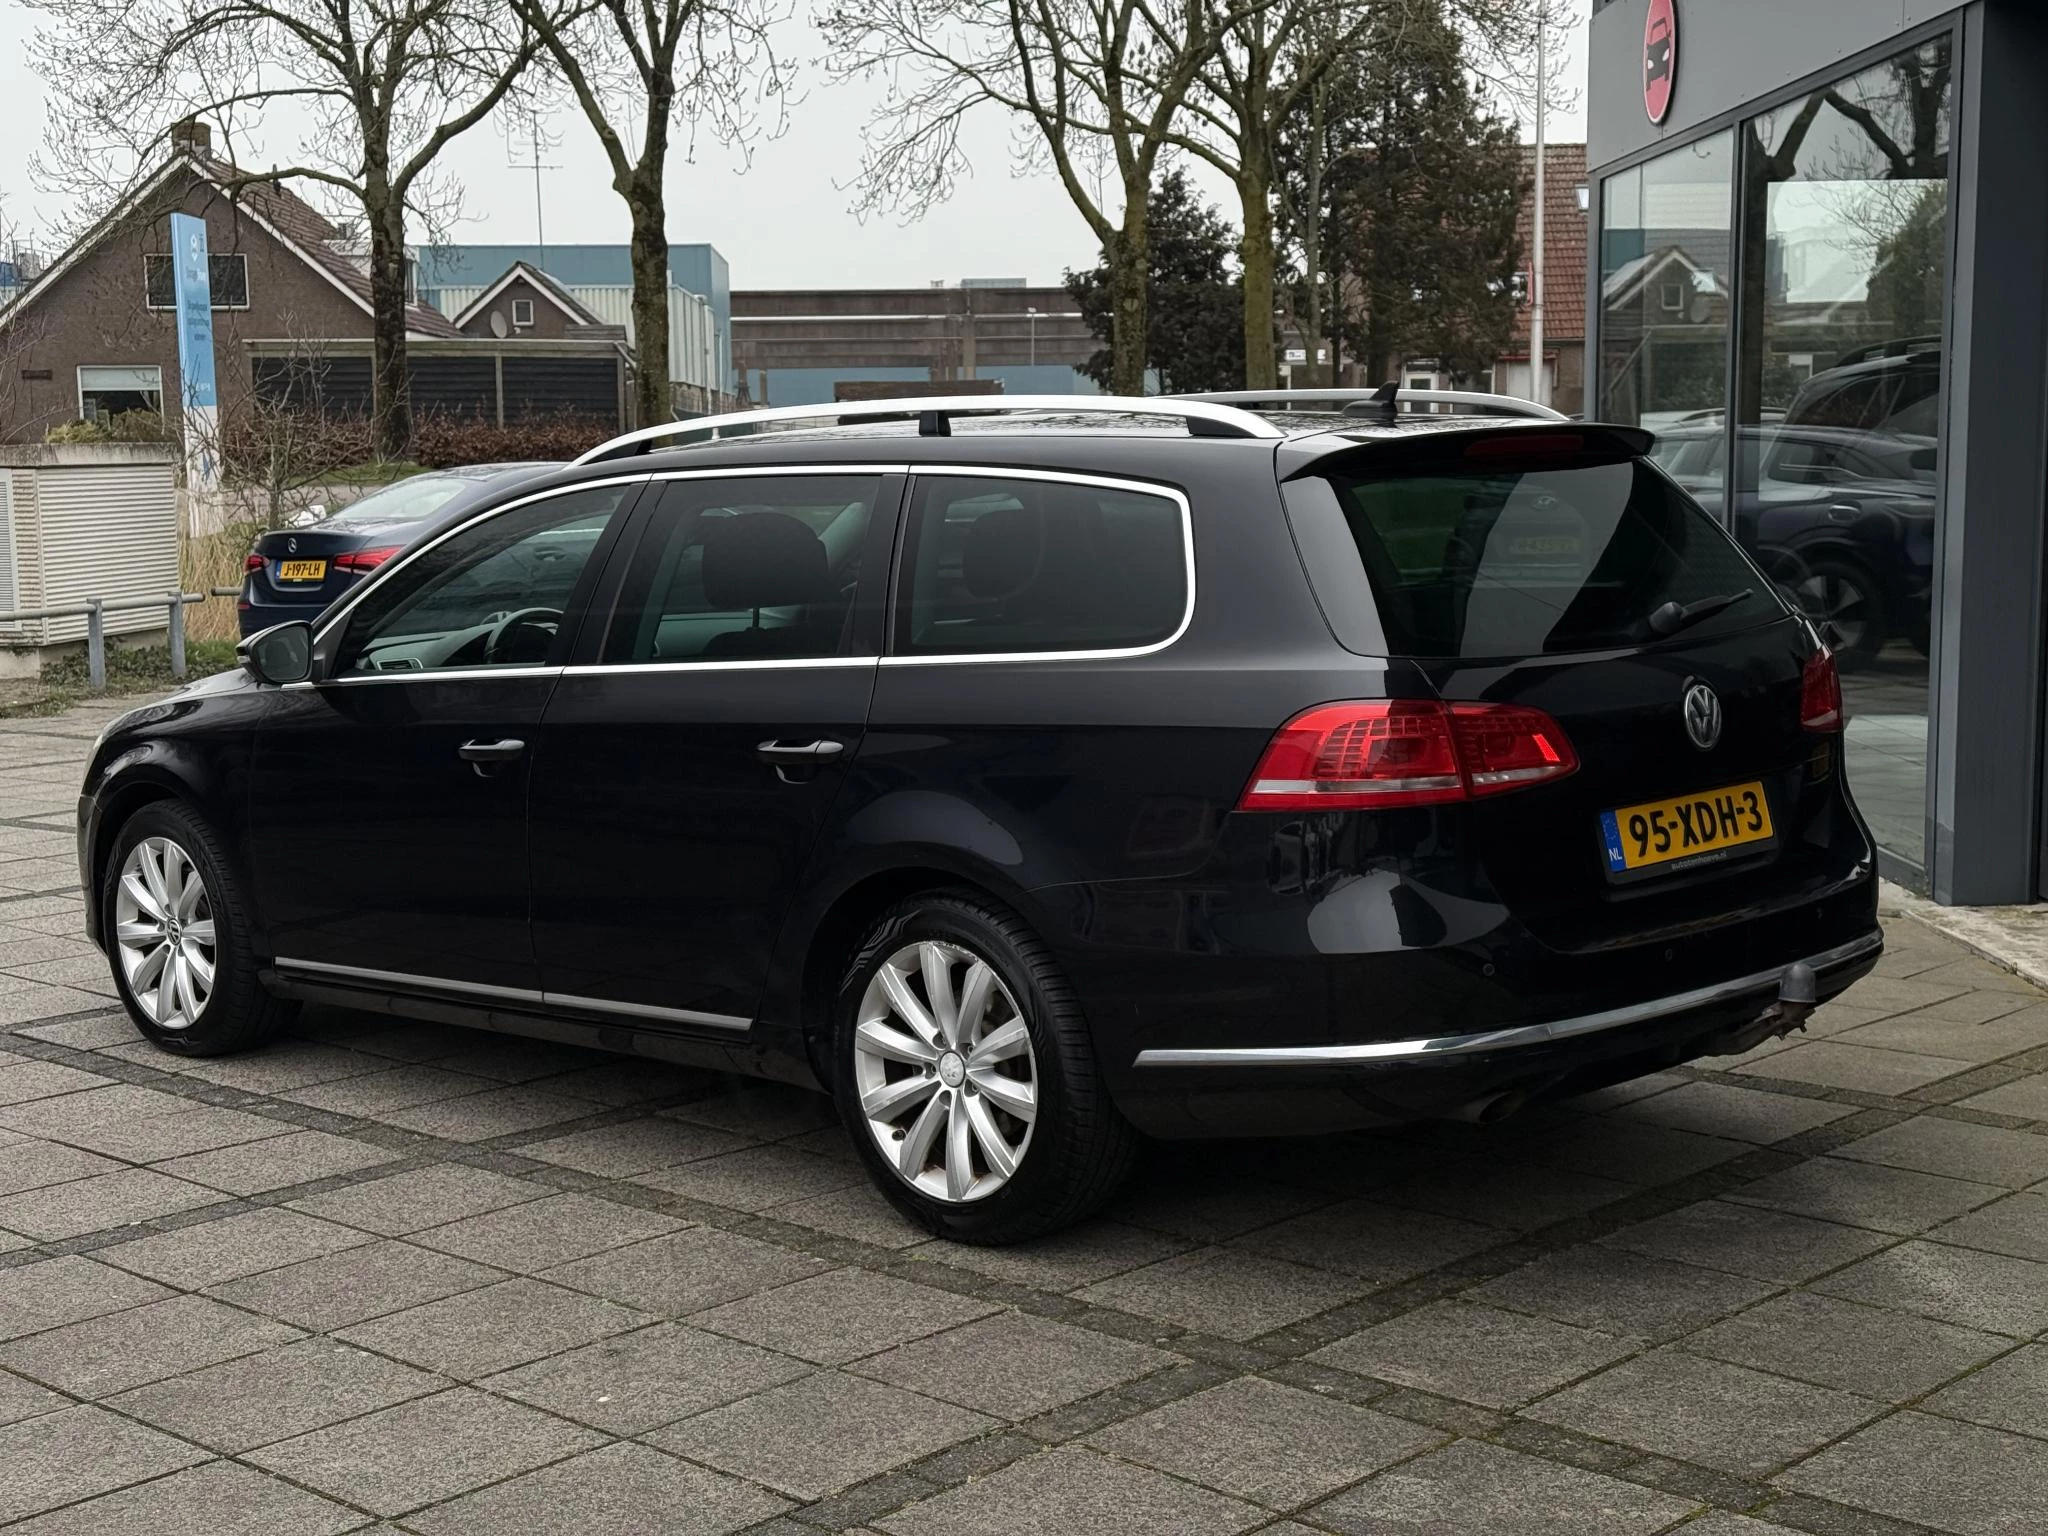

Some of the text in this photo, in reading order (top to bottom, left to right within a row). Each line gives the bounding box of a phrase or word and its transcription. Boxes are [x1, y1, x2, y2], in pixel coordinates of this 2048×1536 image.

[284, 563, 321, 577] J-197-LH
[1628, 790, 1763, 858] 95-XDH-3
[1608, 847, 1623, 862] NL
